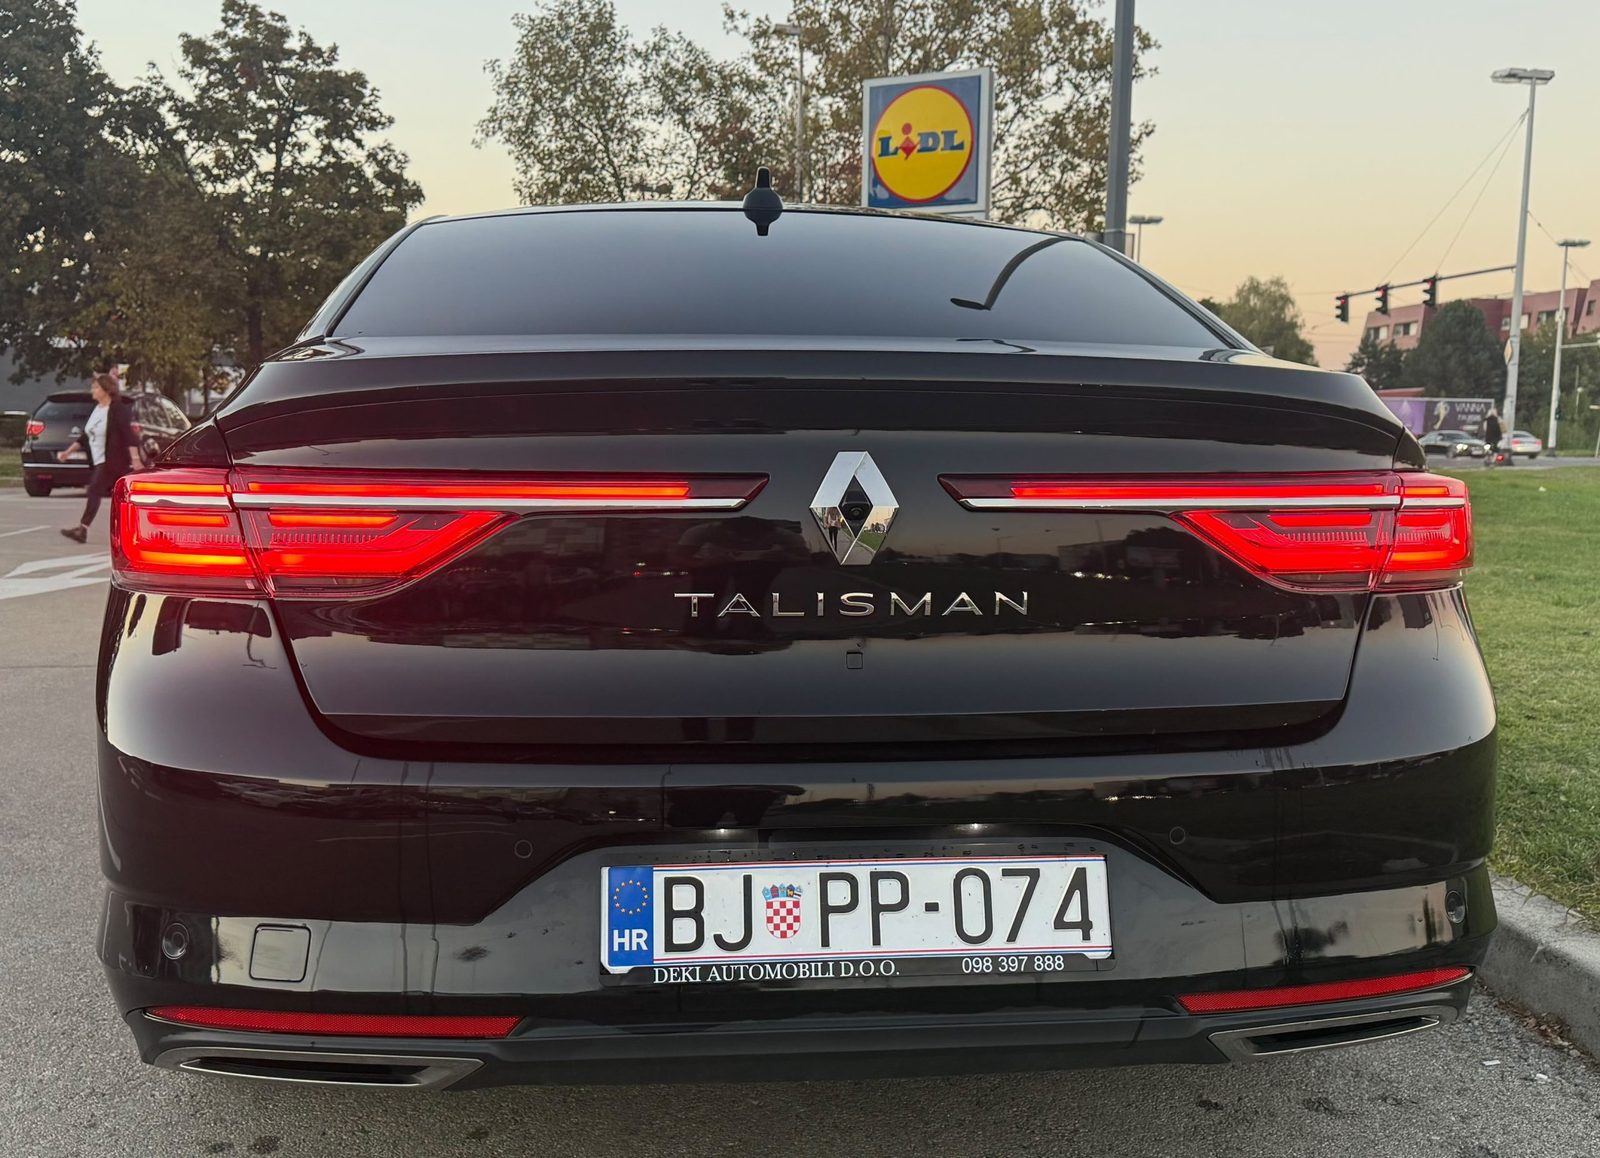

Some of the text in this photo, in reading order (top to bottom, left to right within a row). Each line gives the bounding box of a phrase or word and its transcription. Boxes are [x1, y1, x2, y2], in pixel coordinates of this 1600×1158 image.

[674, 591, 1028, 617] TALISMAN
[663, 867, 1093, 953] BJ PP-074
[613, 929, 648, 951] HR
[653, 960, 900, 984] DEKI AUTOMOBILI D.O.O.
[961, 955, 1065, 974] 098 397 888
